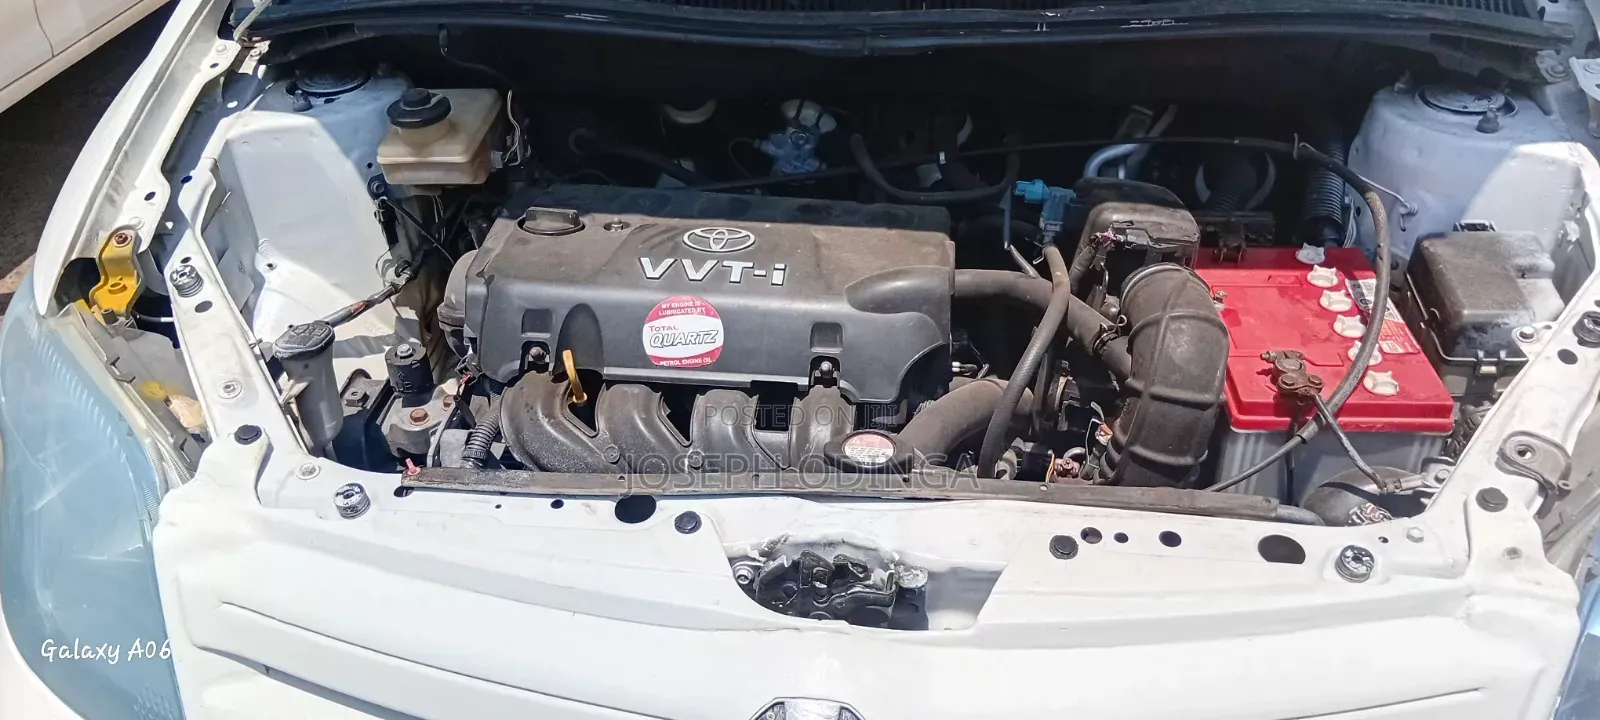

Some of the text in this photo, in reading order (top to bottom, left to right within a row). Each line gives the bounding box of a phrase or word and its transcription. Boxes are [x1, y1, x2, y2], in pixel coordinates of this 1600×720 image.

[638, 257, 787, 286] VVT-i
[658, 307, 696, 315] LUBRICATED
[650, 330, 719, 348] QUARTZ
